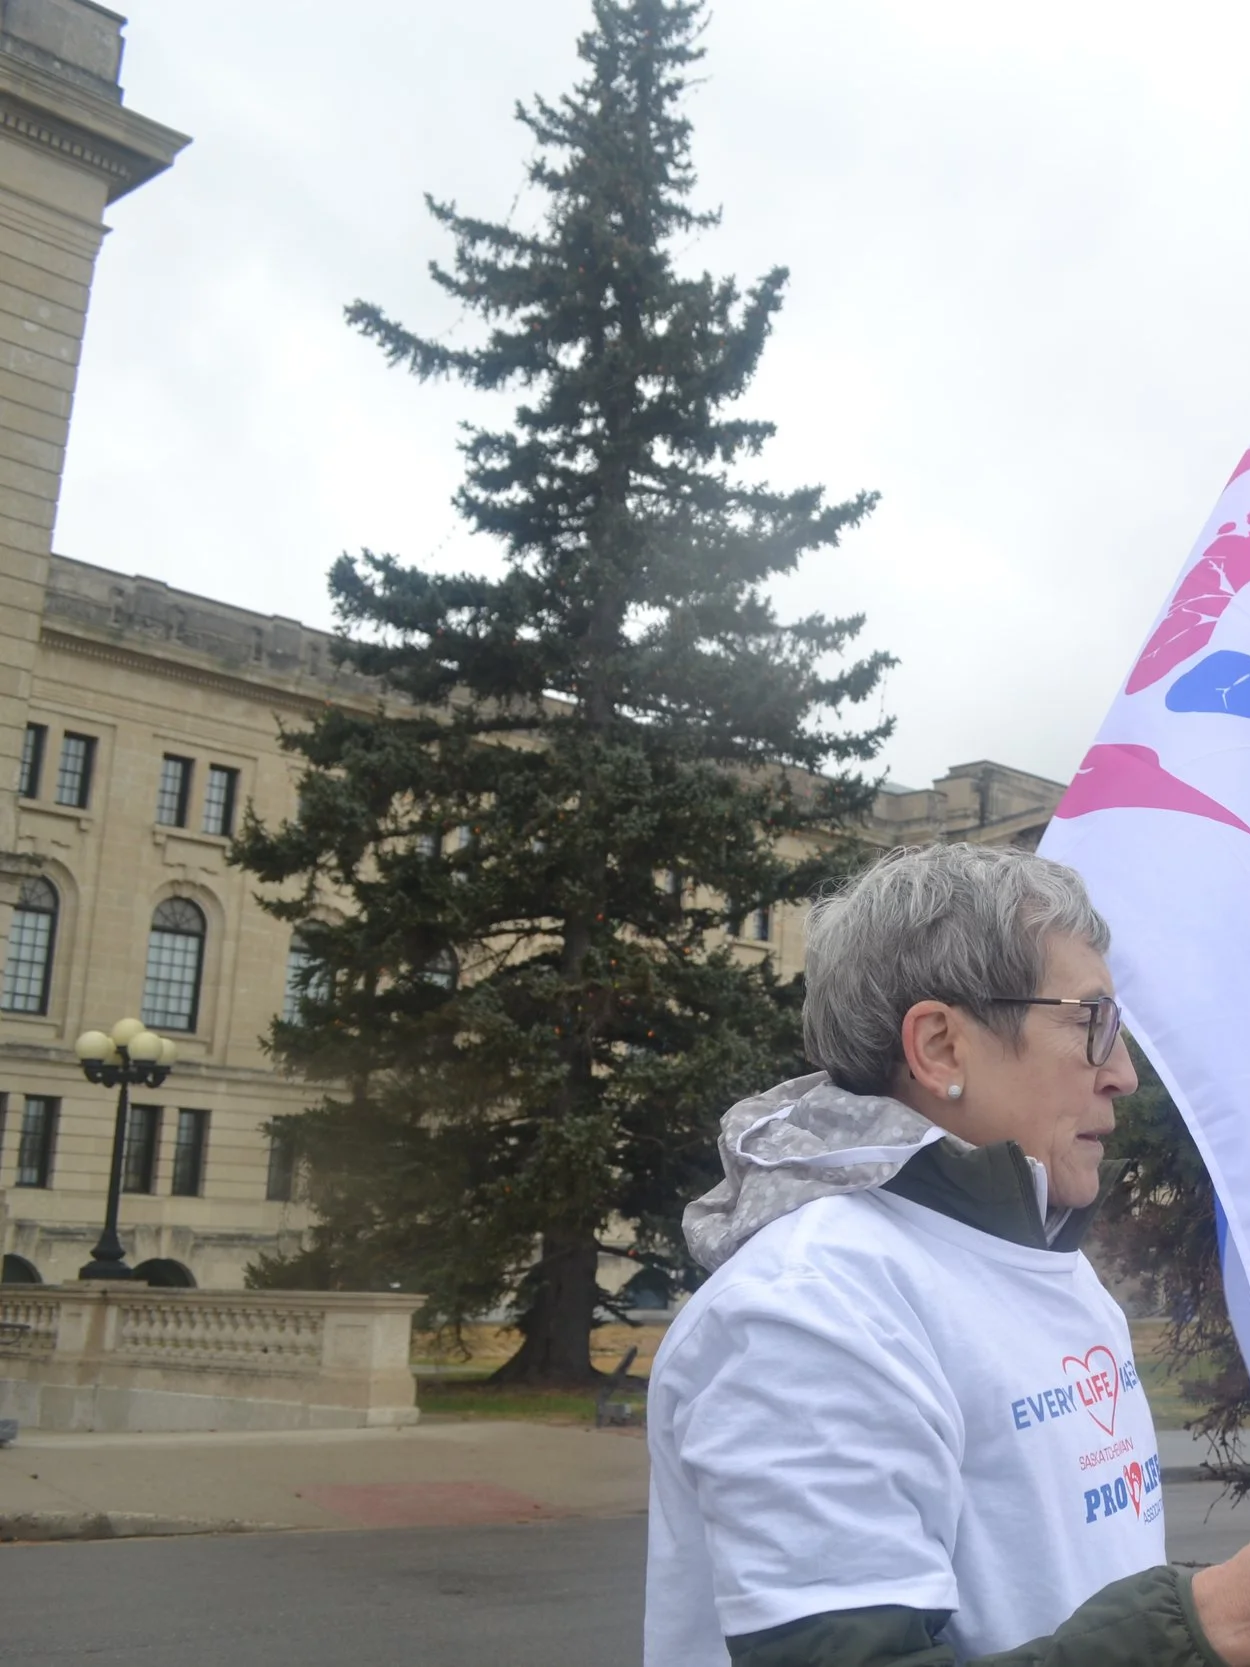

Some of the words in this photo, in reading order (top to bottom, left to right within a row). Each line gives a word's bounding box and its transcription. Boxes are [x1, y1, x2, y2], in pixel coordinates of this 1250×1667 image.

[1011, 1385, 1077, 1430] EVERY
[1076, 1371, 1113, 1407] LIFE
[1084, 1477, 1128, 1523] PRO
